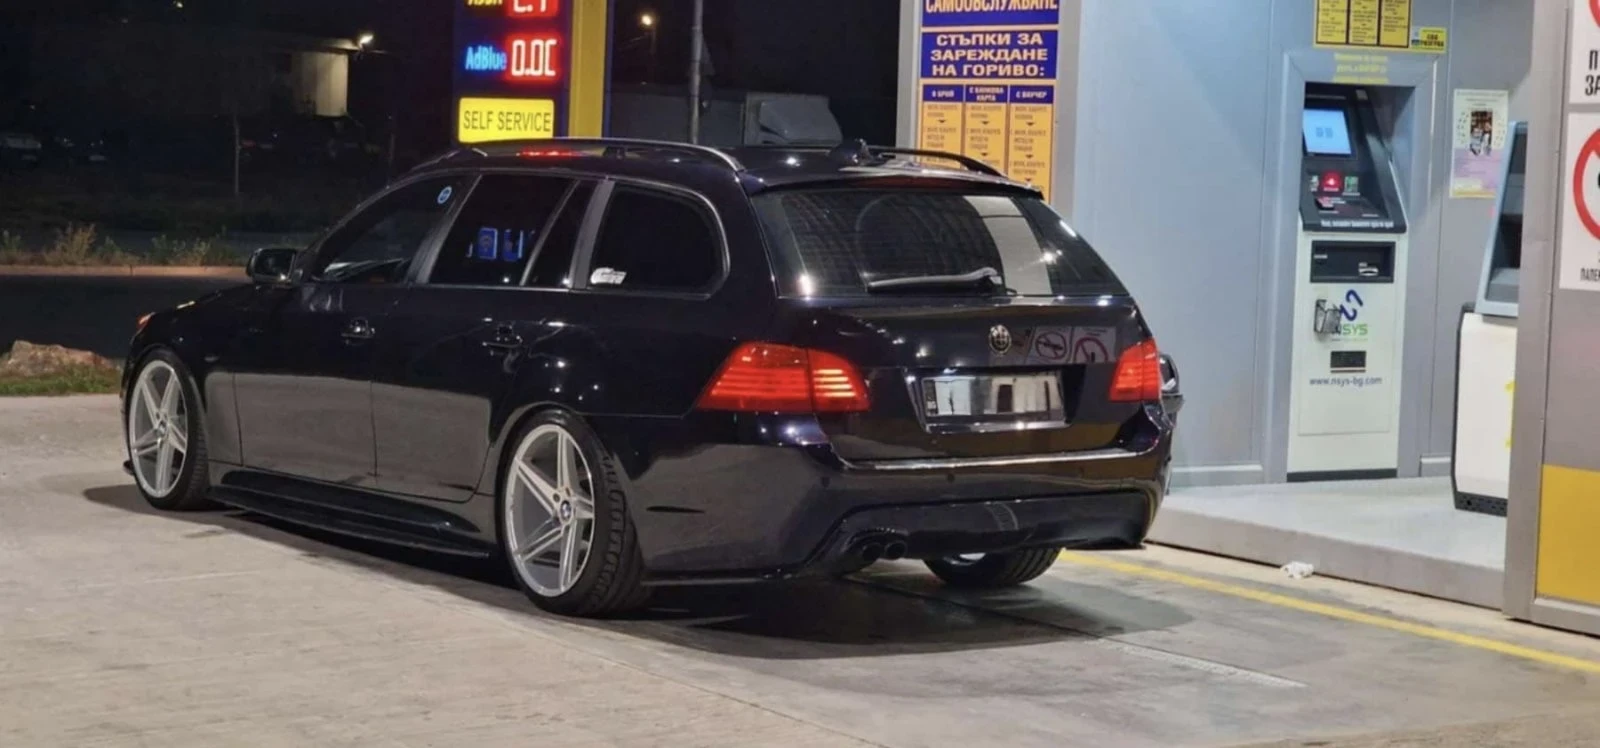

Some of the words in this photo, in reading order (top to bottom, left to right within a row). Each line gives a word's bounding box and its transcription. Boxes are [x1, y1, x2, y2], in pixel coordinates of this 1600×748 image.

[936, 33, 1011, 46] СТЪПКИ
[1017, 32, 1043, 45] ЗА
[465, 45, 507, 71] AdBlue
[930, 49, 1048, 62] ЗАРЕЖДАНЕ
[932, 65, 957, 76] НА
[962, 64, 1045, 77] ГОРИВО:
[463, 110, 494, 130] SELF
[497, 111, 552, 132] SERVICE
[1309, 375, 1383, 388] www.nsys-bg.com
